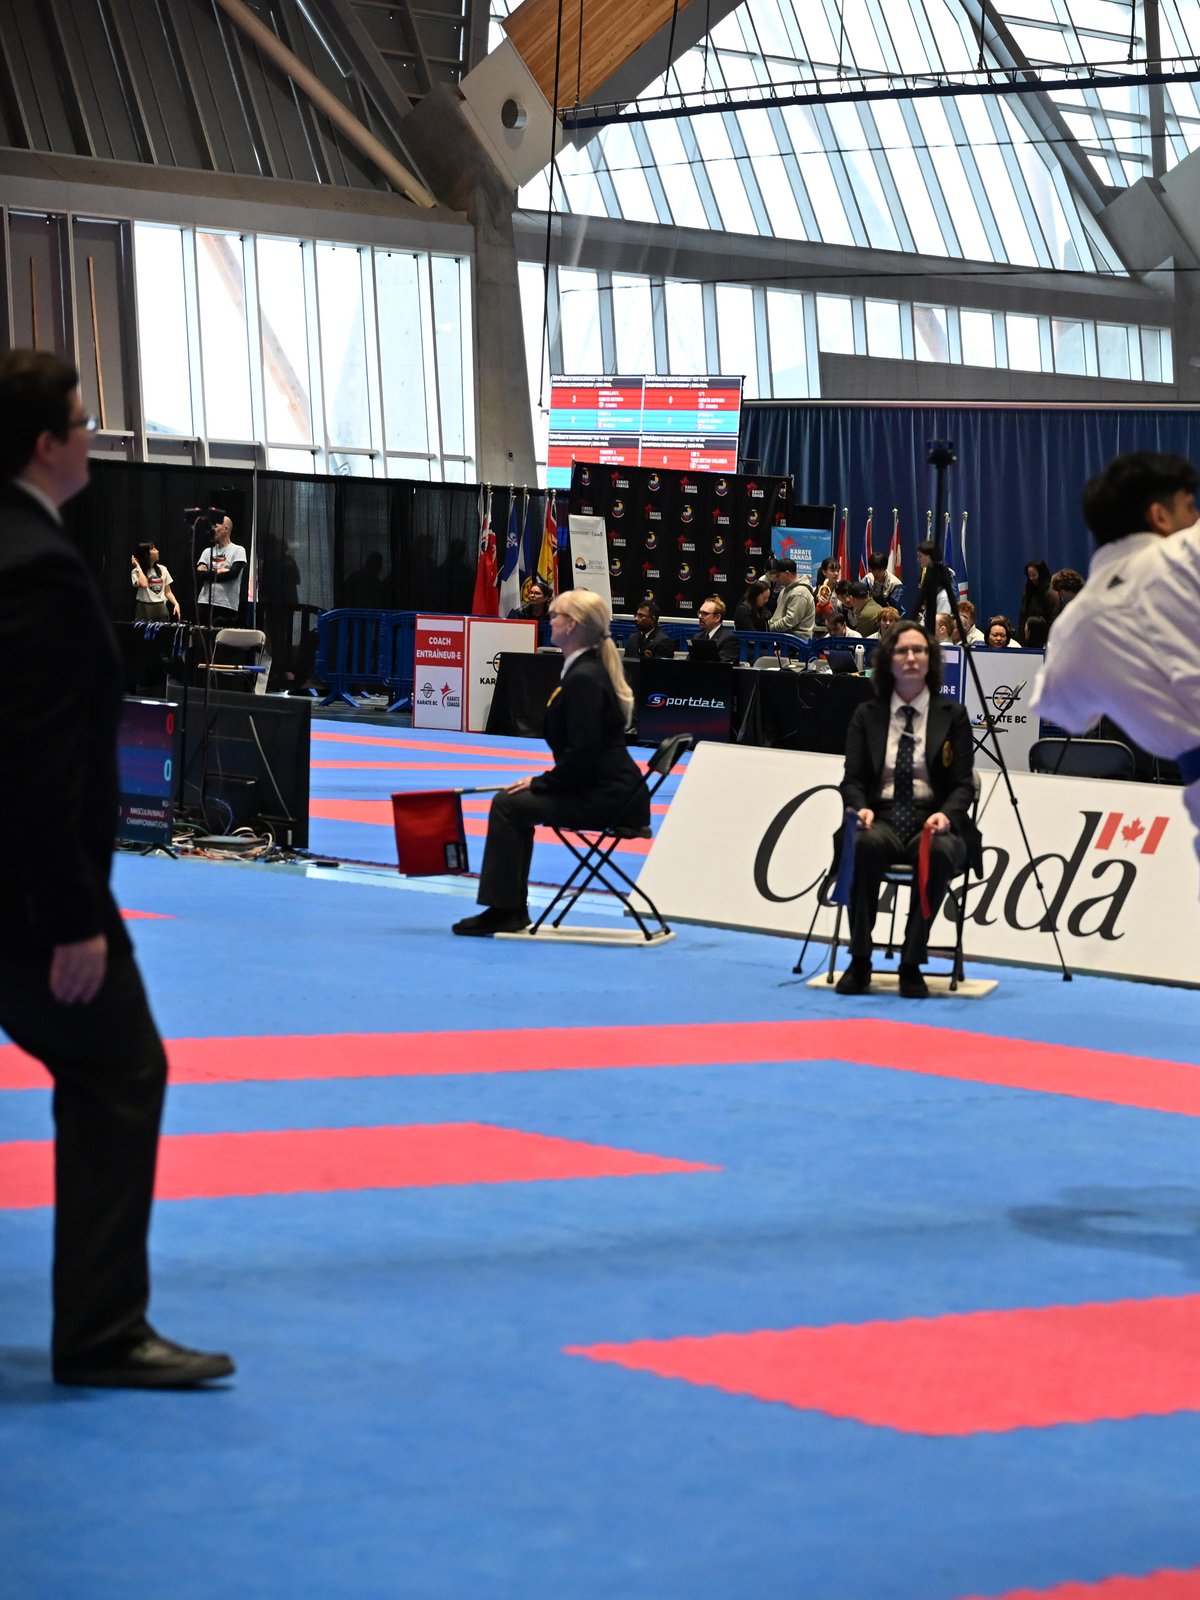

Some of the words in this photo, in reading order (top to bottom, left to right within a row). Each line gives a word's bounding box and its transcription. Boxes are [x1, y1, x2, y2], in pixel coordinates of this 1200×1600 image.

[428, 636, 451, 646] COACH
[479, 677, 497, 685] KAR
[166, 713, 174, 734] 0
[1014, 715, 1027, 724] BC
[164, 759, 172, 781] 0
